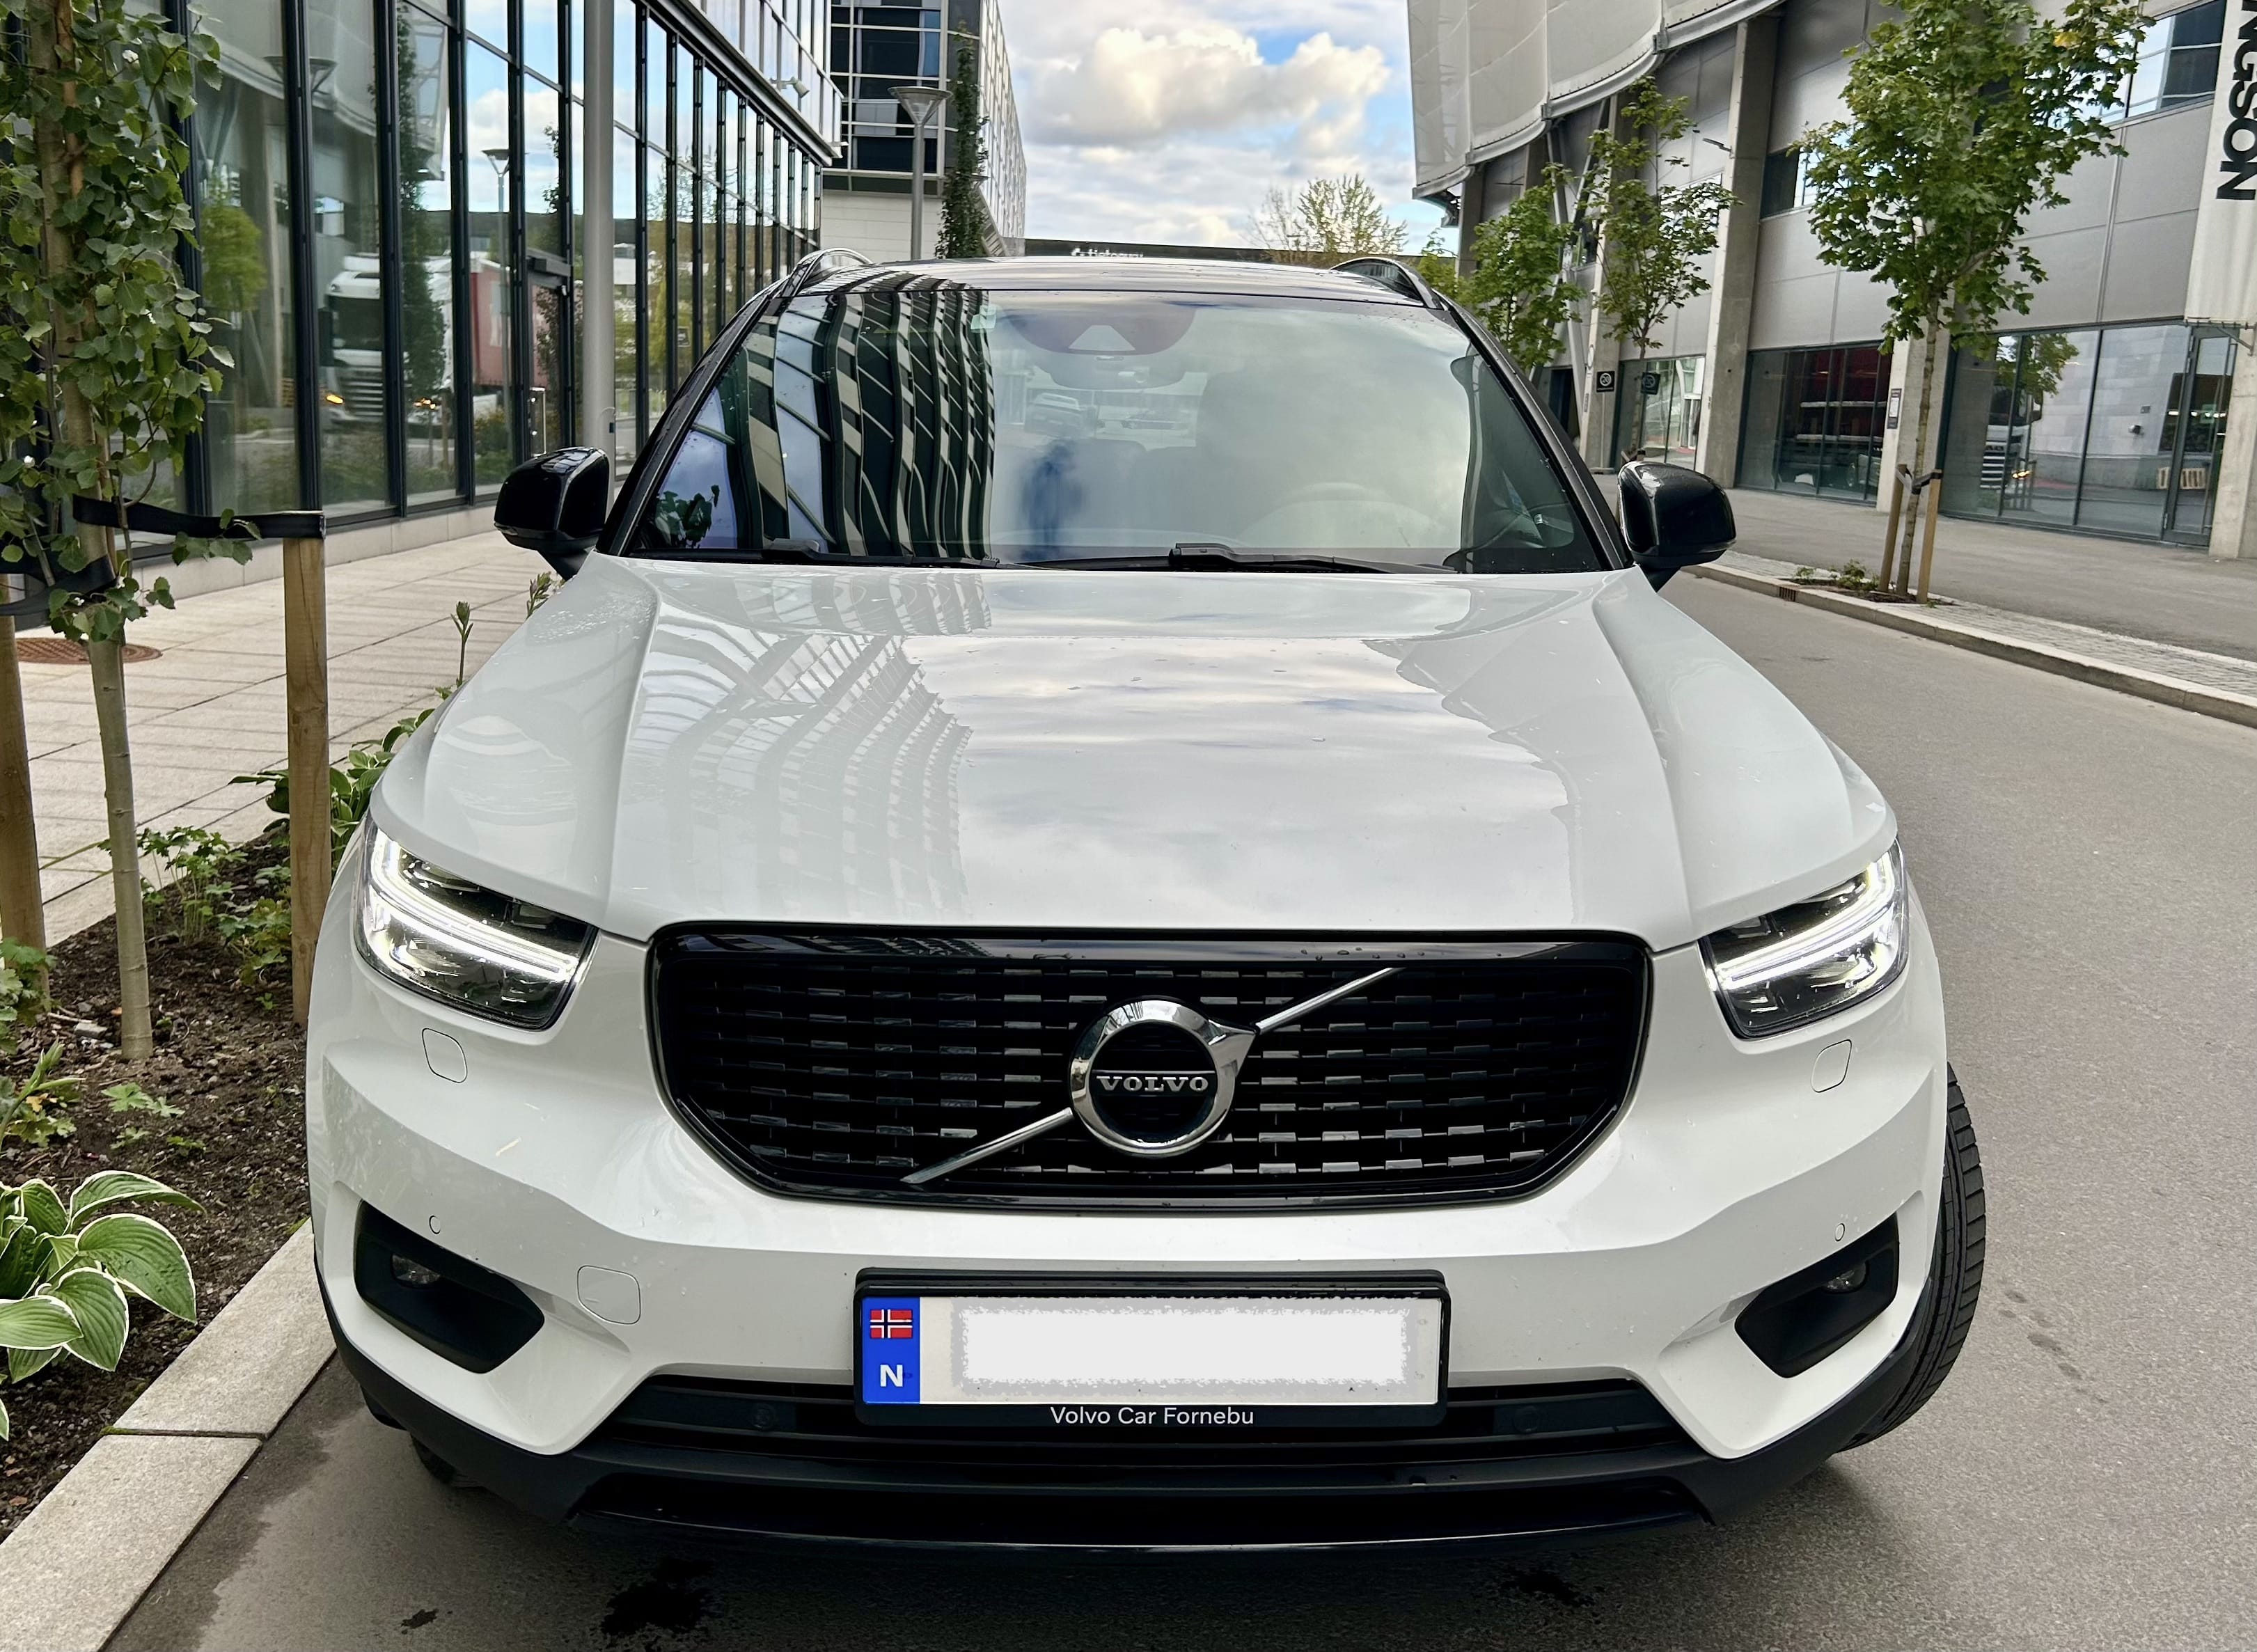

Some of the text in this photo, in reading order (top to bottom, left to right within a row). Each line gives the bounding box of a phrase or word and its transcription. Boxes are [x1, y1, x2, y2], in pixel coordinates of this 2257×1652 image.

[1096, 1076, 1209, 1092] VOLVO
[879, 1364, 904, 1387] N
[1050, 1406, 1254, 1424] Volvo Car Fornebu
